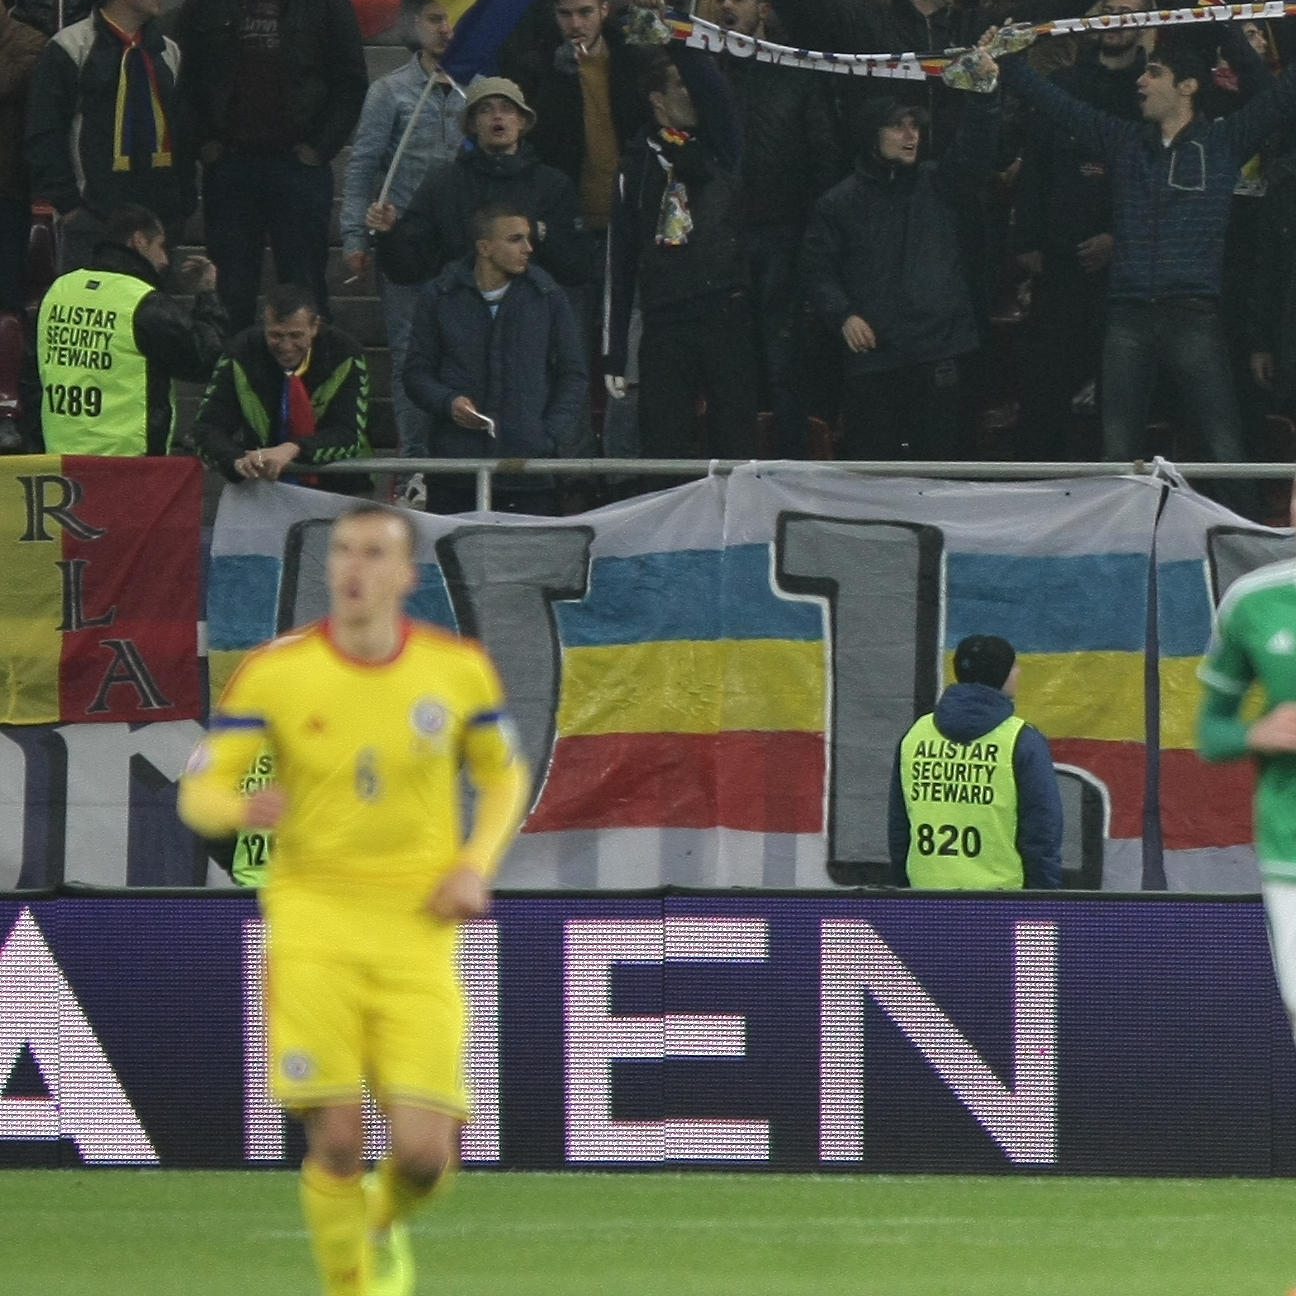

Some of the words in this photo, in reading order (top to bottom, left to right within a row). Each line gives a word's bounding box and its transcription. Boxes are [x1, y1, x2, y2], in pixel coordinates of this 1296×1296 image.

[48, 305, 117, 340] ALISTAR
[46, 325, 113, 351] SECURITY
[45, 383, 102, 417] 1289
[914, 740, 998, 762] ALISTAR
[912, 762, 996, 783] SECURITY
[910, 783, 994, 805] STEWARD
[917, 823, 981, 858] 820
